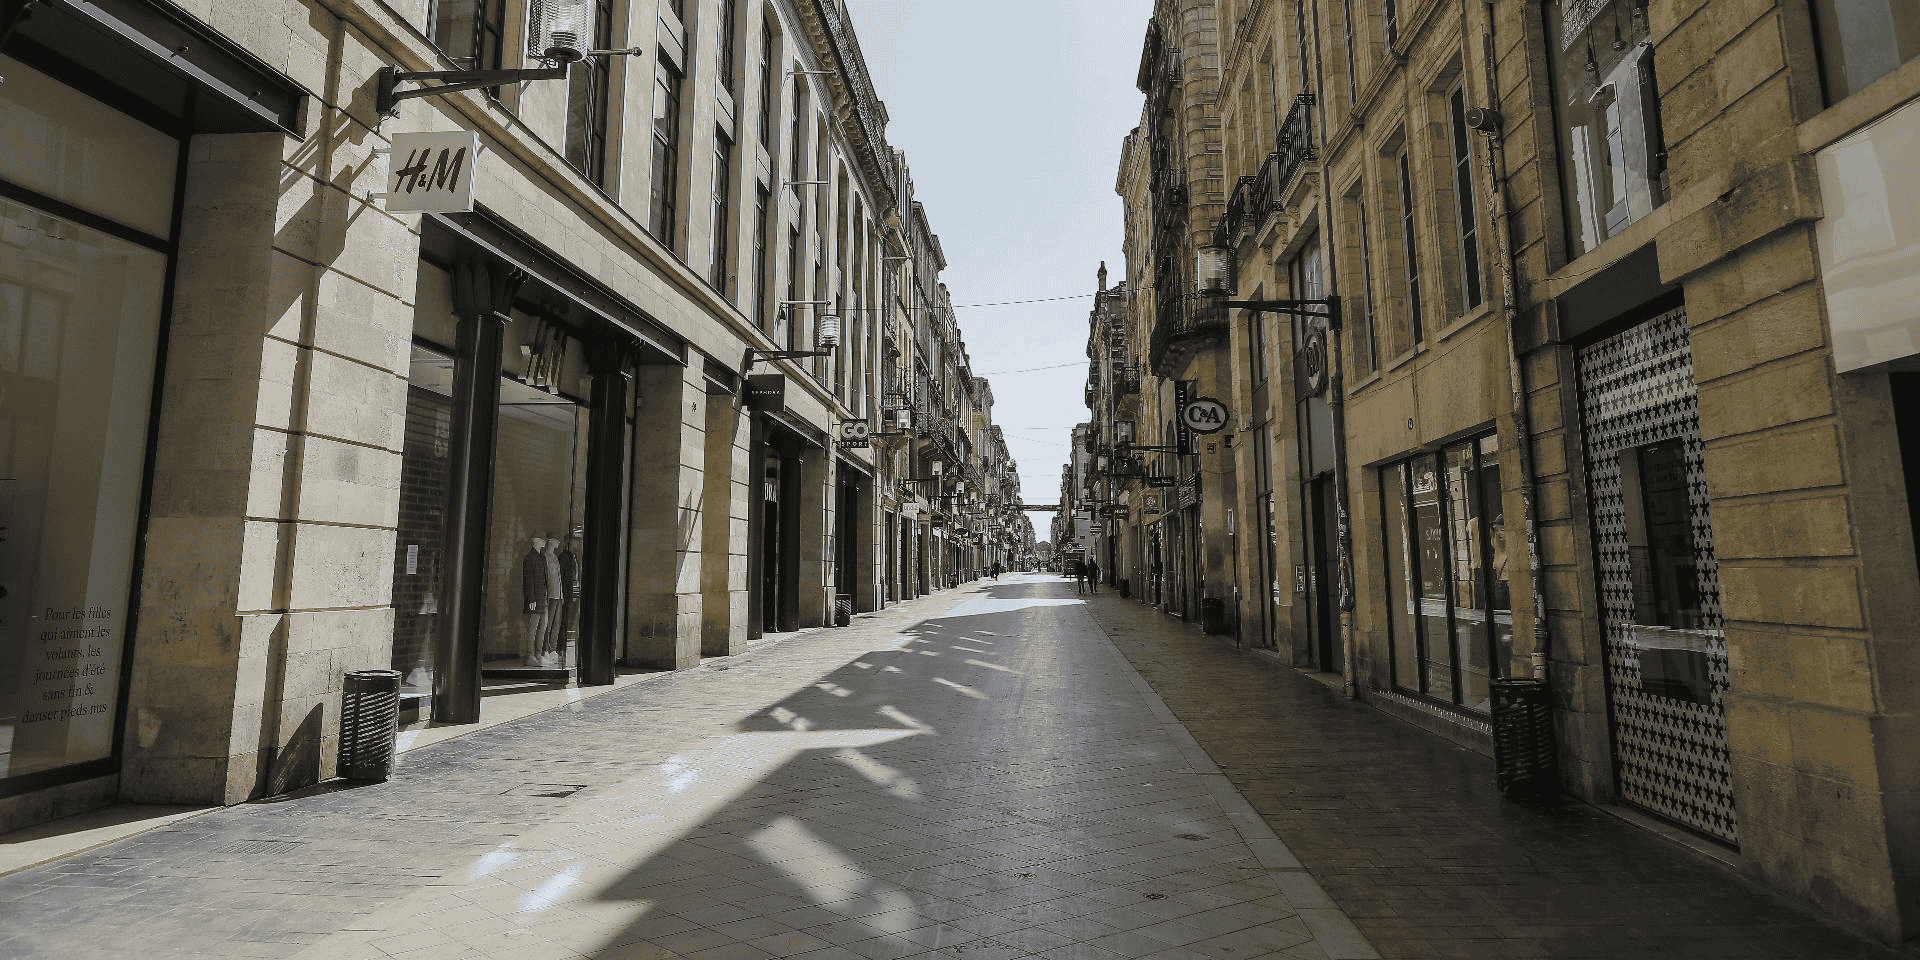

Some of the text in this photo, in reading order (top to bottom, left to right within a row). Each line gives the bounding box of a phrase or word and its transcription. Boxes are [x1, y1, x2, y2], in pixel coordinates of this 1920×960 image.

[395, 147, 466, 194] H&M
[1188, 406, 1221, 423] C&A
[841, 422, 869, 438] GO
[44, 606, 111, 621] Pour les filles
[40, 625, 111, 644] qui aiment les
[46, 644, 101, 660] volants, les
[32, 666, 80, 685] journées
[43, 683, 94, 701] sans fin &
[21, 703, 107, 724] danser pieds nus
